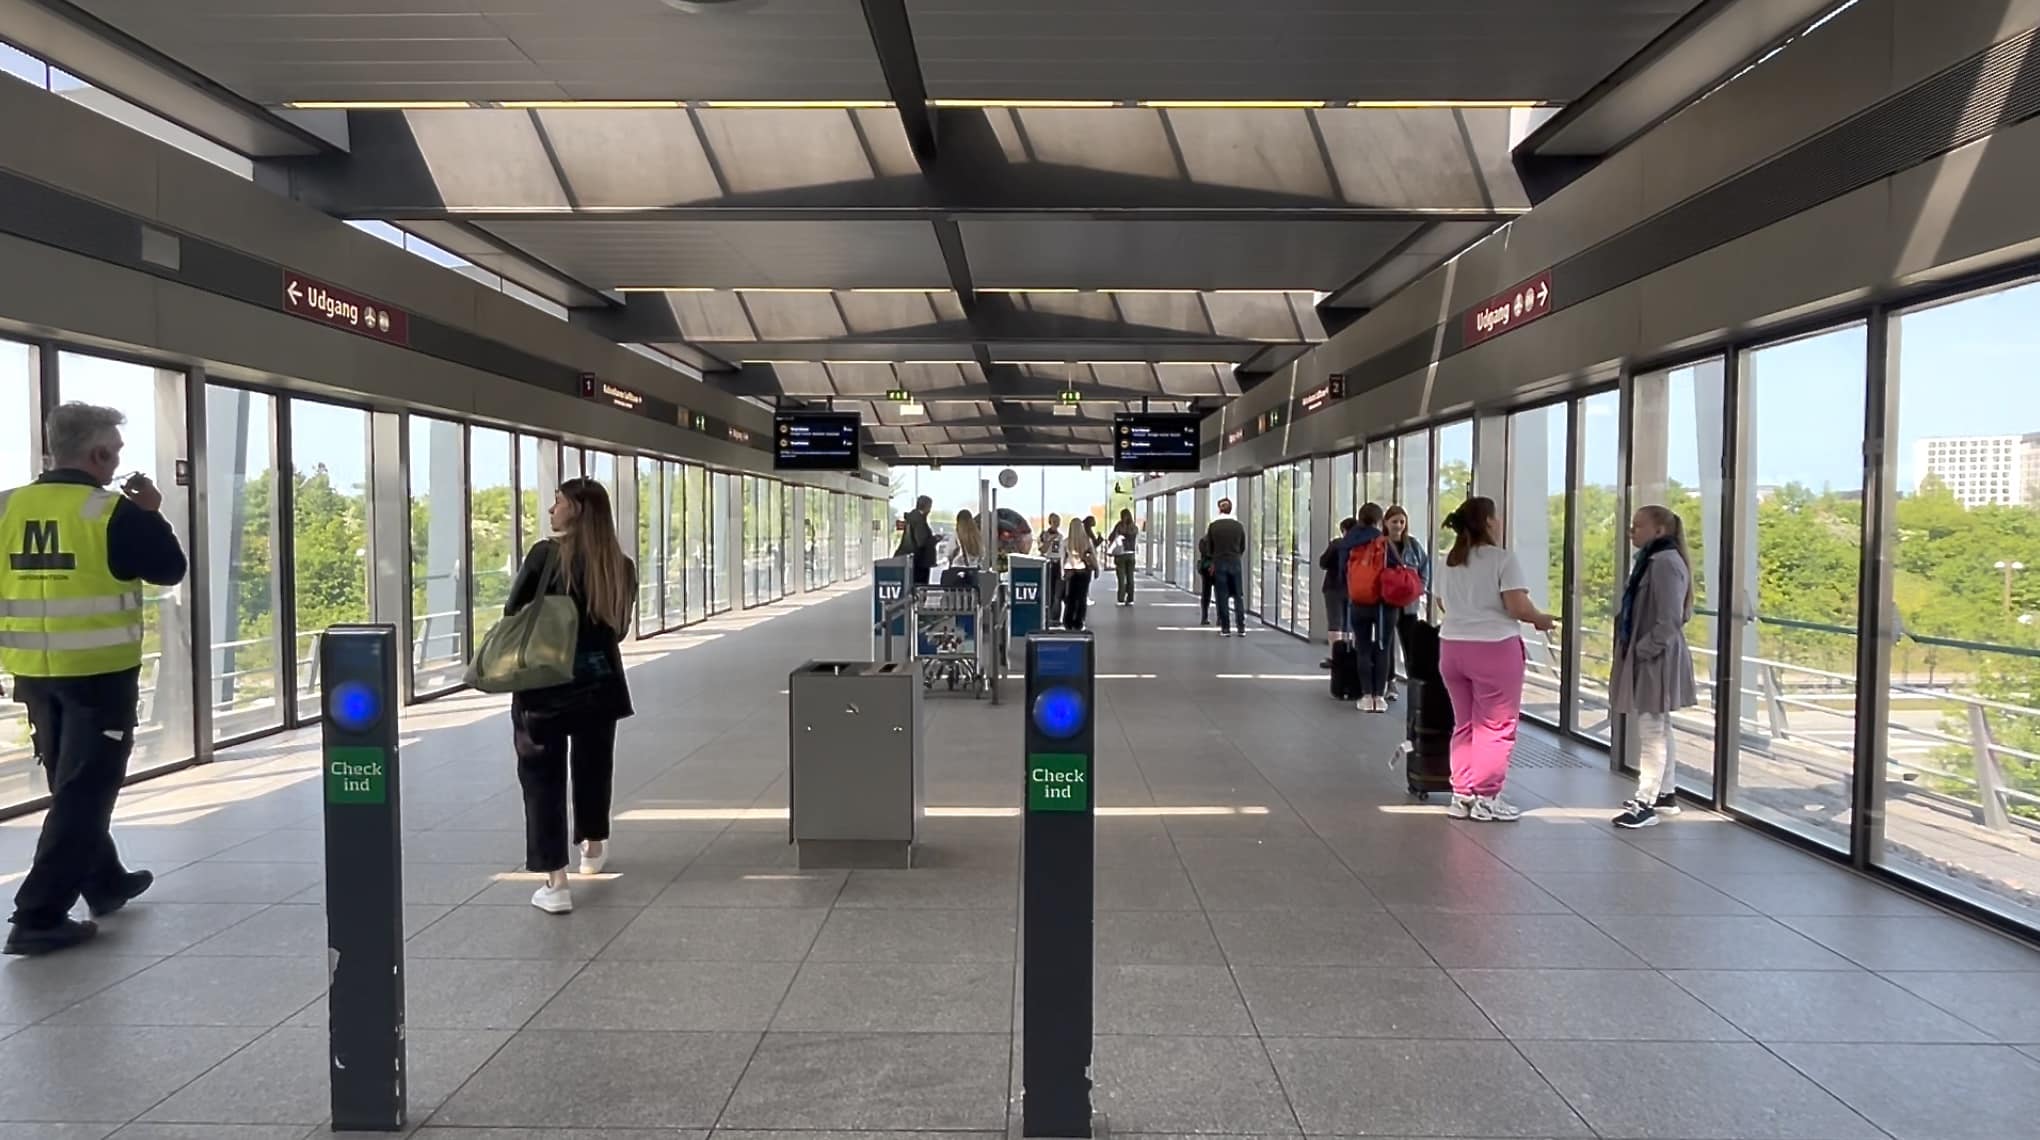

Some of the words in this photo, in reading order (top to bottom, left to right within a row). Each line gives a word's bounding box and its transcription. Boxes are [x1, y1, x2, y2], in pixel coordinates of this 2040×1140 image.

[307, 286, 358, 325] Udgang
[1477, 303, 1510, 331] Udgang
[22, 520, 60, 555] M
[878, 586, 901, 599] LIV
[1015, 587, 1038, 600] LIV
[331, 761, 383, 776] Check
[1032, 768, 1085, 782] Check
[343, 778, 370, 792] ind
[1044, 785, 1072, 798] ind
